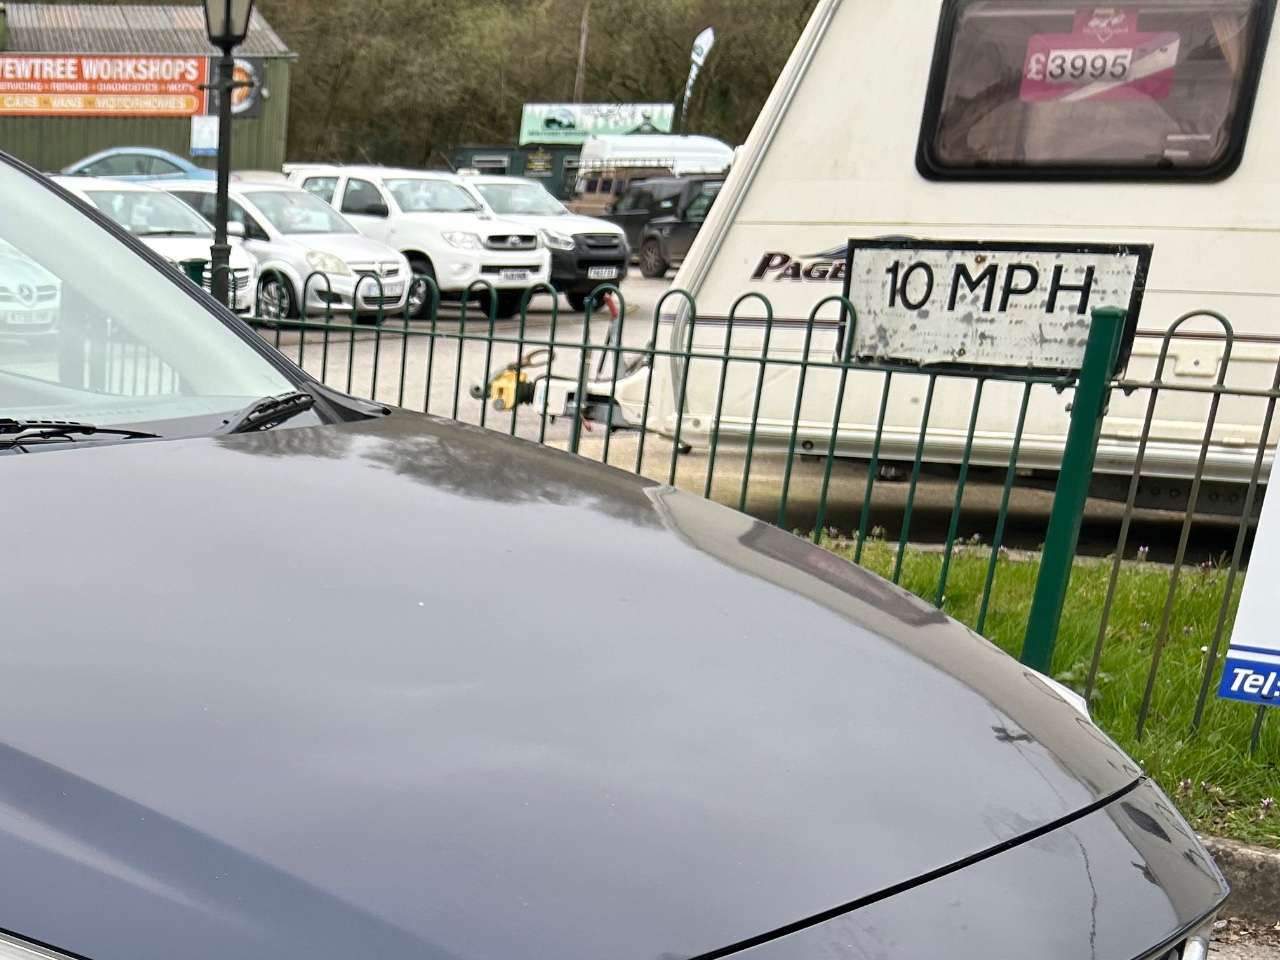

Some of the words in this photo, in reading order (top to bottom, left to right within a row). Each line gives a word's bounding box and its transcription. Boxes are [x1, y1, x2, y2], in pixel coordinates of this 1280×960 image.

[81, 57, 199, 81] WORKSHOPS
[1026, 53, 1129, 81] £3995
[886, 260, 934, 311] 10
[946, 263, 1096, 315] MPH
